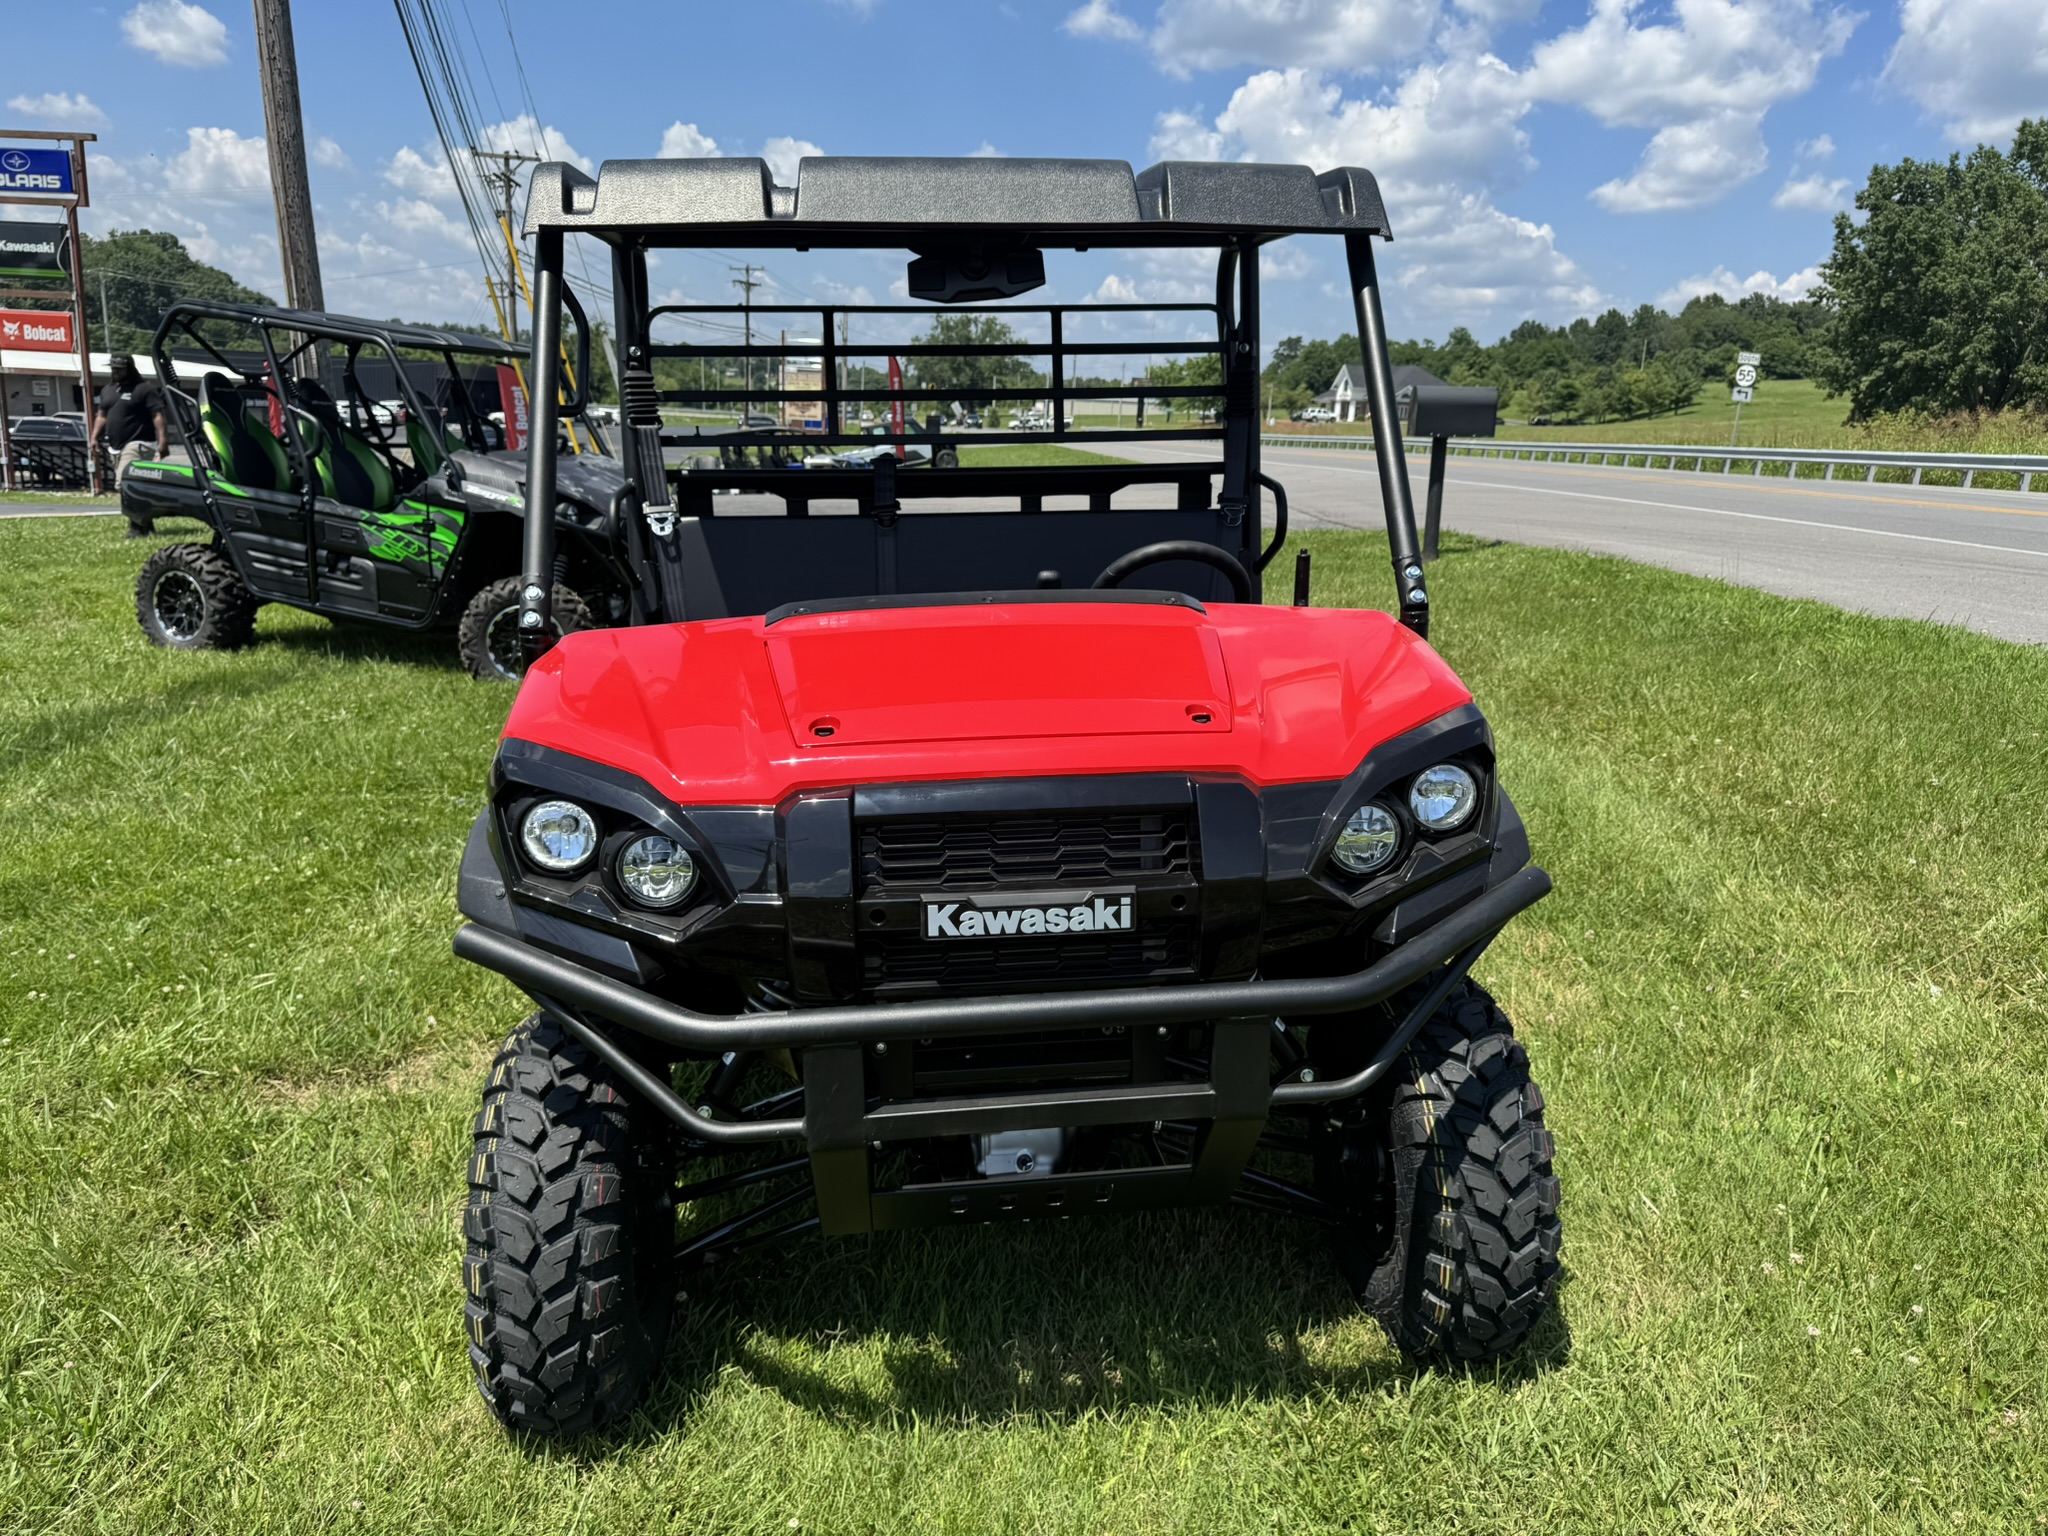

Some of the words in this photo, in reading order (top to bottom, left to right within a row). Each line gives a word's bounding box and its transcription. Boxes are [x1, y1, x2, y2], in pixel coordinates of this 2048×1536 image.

[0, 240, 55, 253] Kawasaki
[23, 324, 66, 342] Bobcat
[1738, 369, 1755, 382] 55
[511, 385, 529, 430] Bobcat
[129, 466, 163, 480] Kawasaki
[927, 897, 1132, 937] Kawasaki
